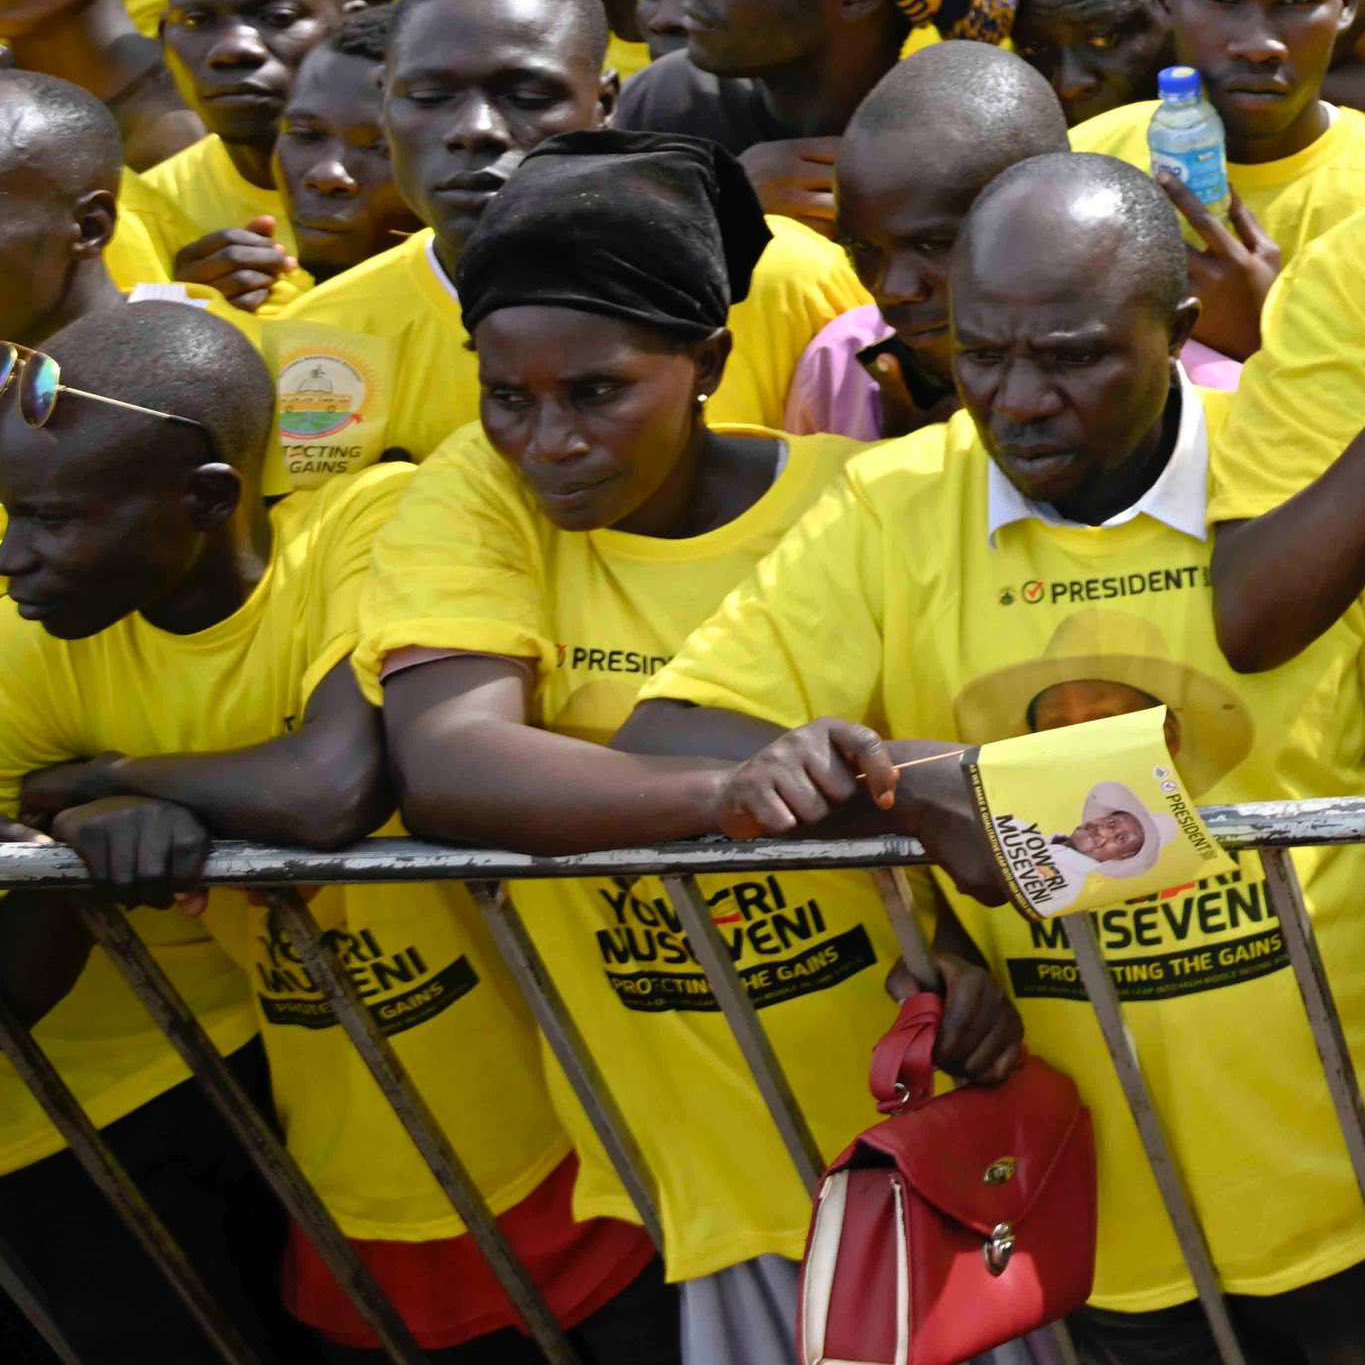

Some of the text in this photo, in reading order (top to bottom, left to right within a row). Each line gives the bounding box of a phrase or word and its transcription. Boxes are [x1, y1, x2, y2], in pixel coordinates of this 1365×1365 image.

[282, 445, 362, 459] TECTING
[290, 460, 348, 475] GAINS
[1051, 566, 1199, 604] PRESIDENT
[572, 647, 674, 676] PRESID
[1166, 793, 1210, 852] PRESIDENT
[995, 814, 1052, 905] MUSEVENI
[1030, 882, 1280, 949] MSEVENI
[745, 968, 773, 990] HE
[776, 945, 840, 981] GAINS
[1037, 962, 1164, 983] PROTING
[1169, 951, 1214, 976] THE
[1218, 934, 1283, 967] GAINS
[379, 981, 444, 1019] GAINS
